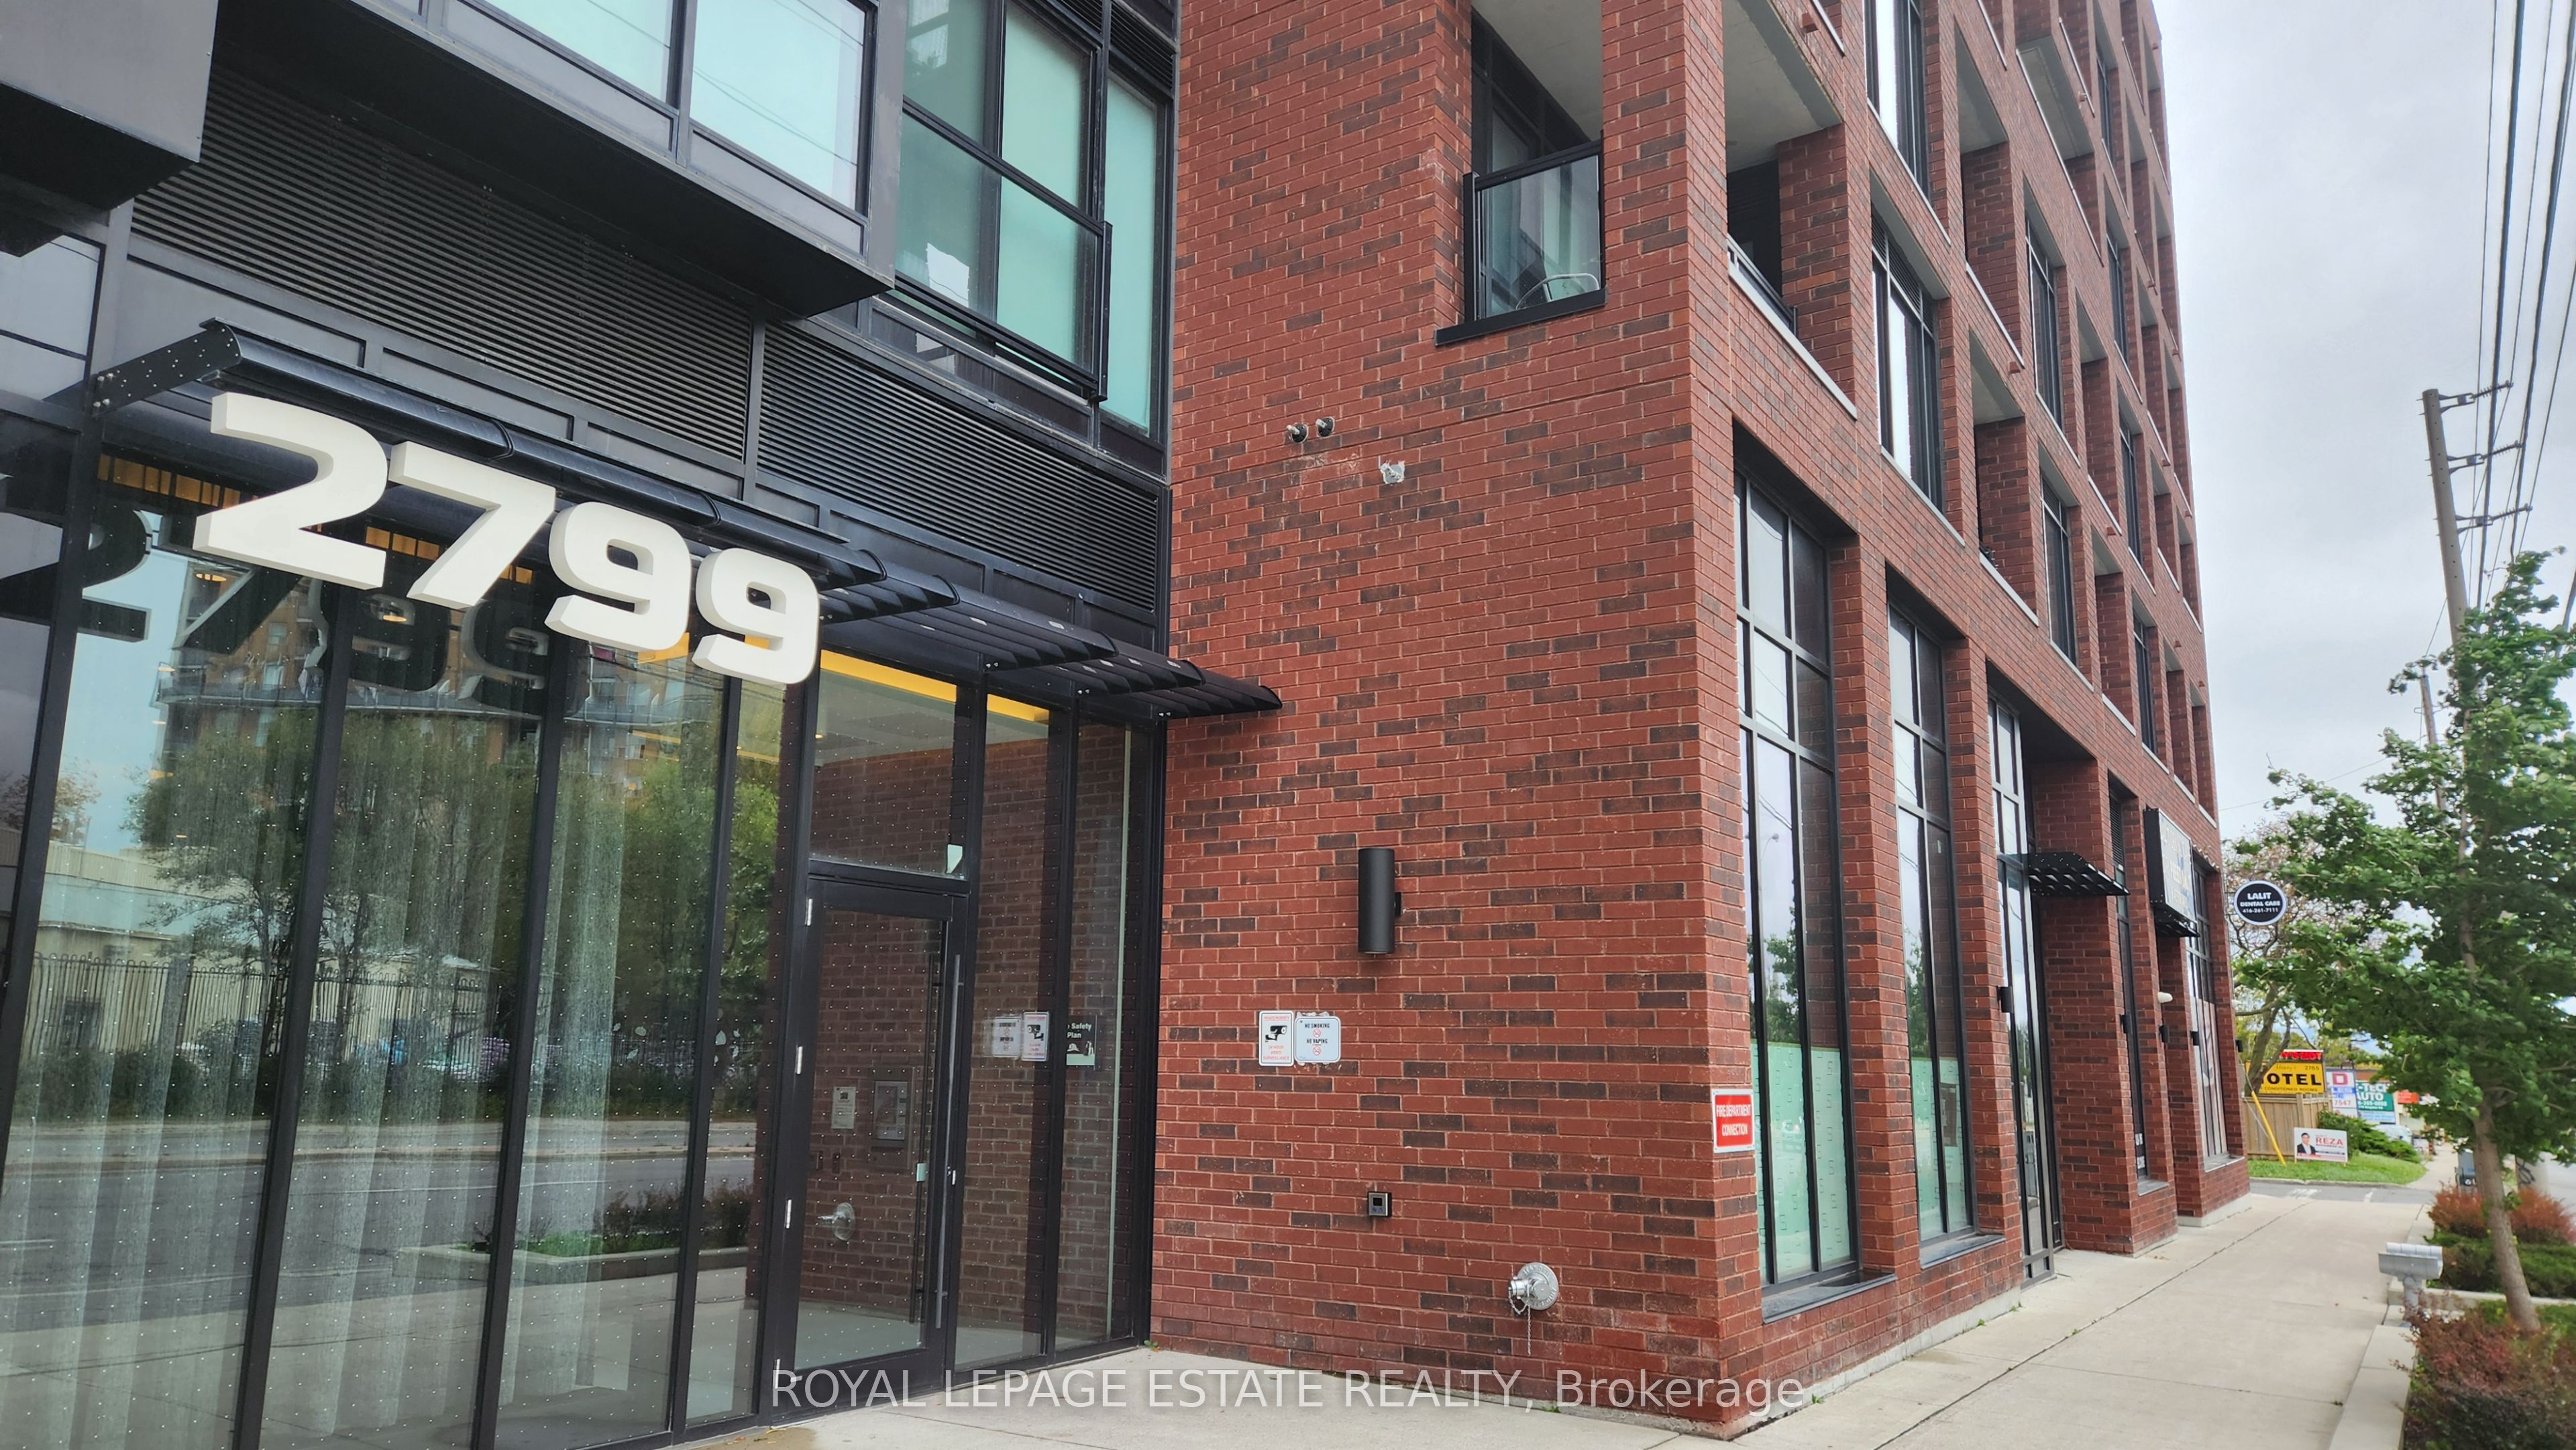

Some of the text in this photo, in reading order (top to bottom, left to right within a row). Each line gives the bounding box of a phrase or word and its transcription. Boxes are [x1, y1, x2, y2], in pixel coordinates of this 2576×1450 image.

[193, 391, 819, 685] 2799
[1071, 1023, 1092, 1032] Safety
[2261, 1073, 2321, 1086] OTEL
[1716, 1104, 1752, 1117] FIRE DEPARTMENT
[1721, 1123, 1748, 1137] CONNECTION
[2315, 1137, 2343, 1146] REZA
